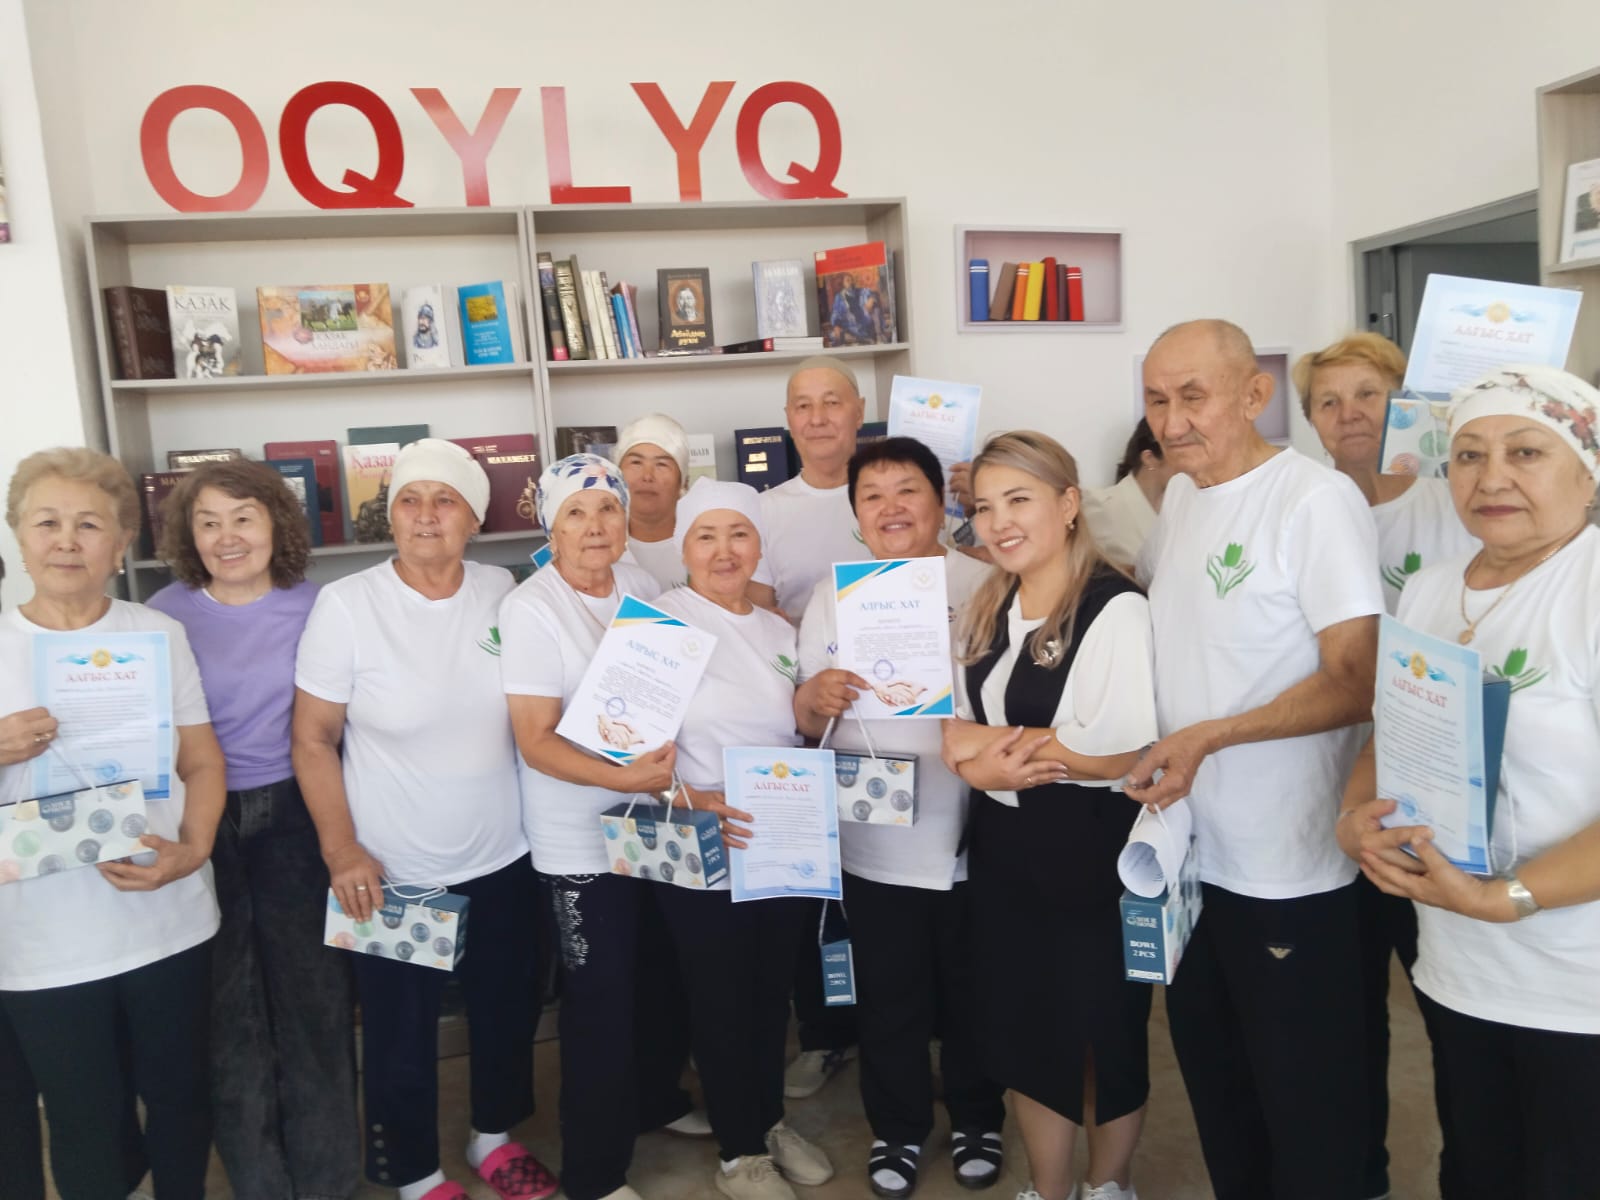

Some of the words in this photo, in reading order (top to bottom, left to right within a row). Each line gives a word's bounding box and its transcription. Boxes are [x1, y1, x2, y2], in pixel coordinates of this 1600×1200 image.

[139, 80, 849, 213] OQYLYQ
[900, 599, 921, 609] ХАТ
[660, 655, 681, 670] ХАТ
[114, 670, 138, 681] ХАТ
[1425, 690, 1448, 709] ХАТ
[791, 783, 811, 793] ХАТ
[1129, 940, 1159, 950] BOWL
